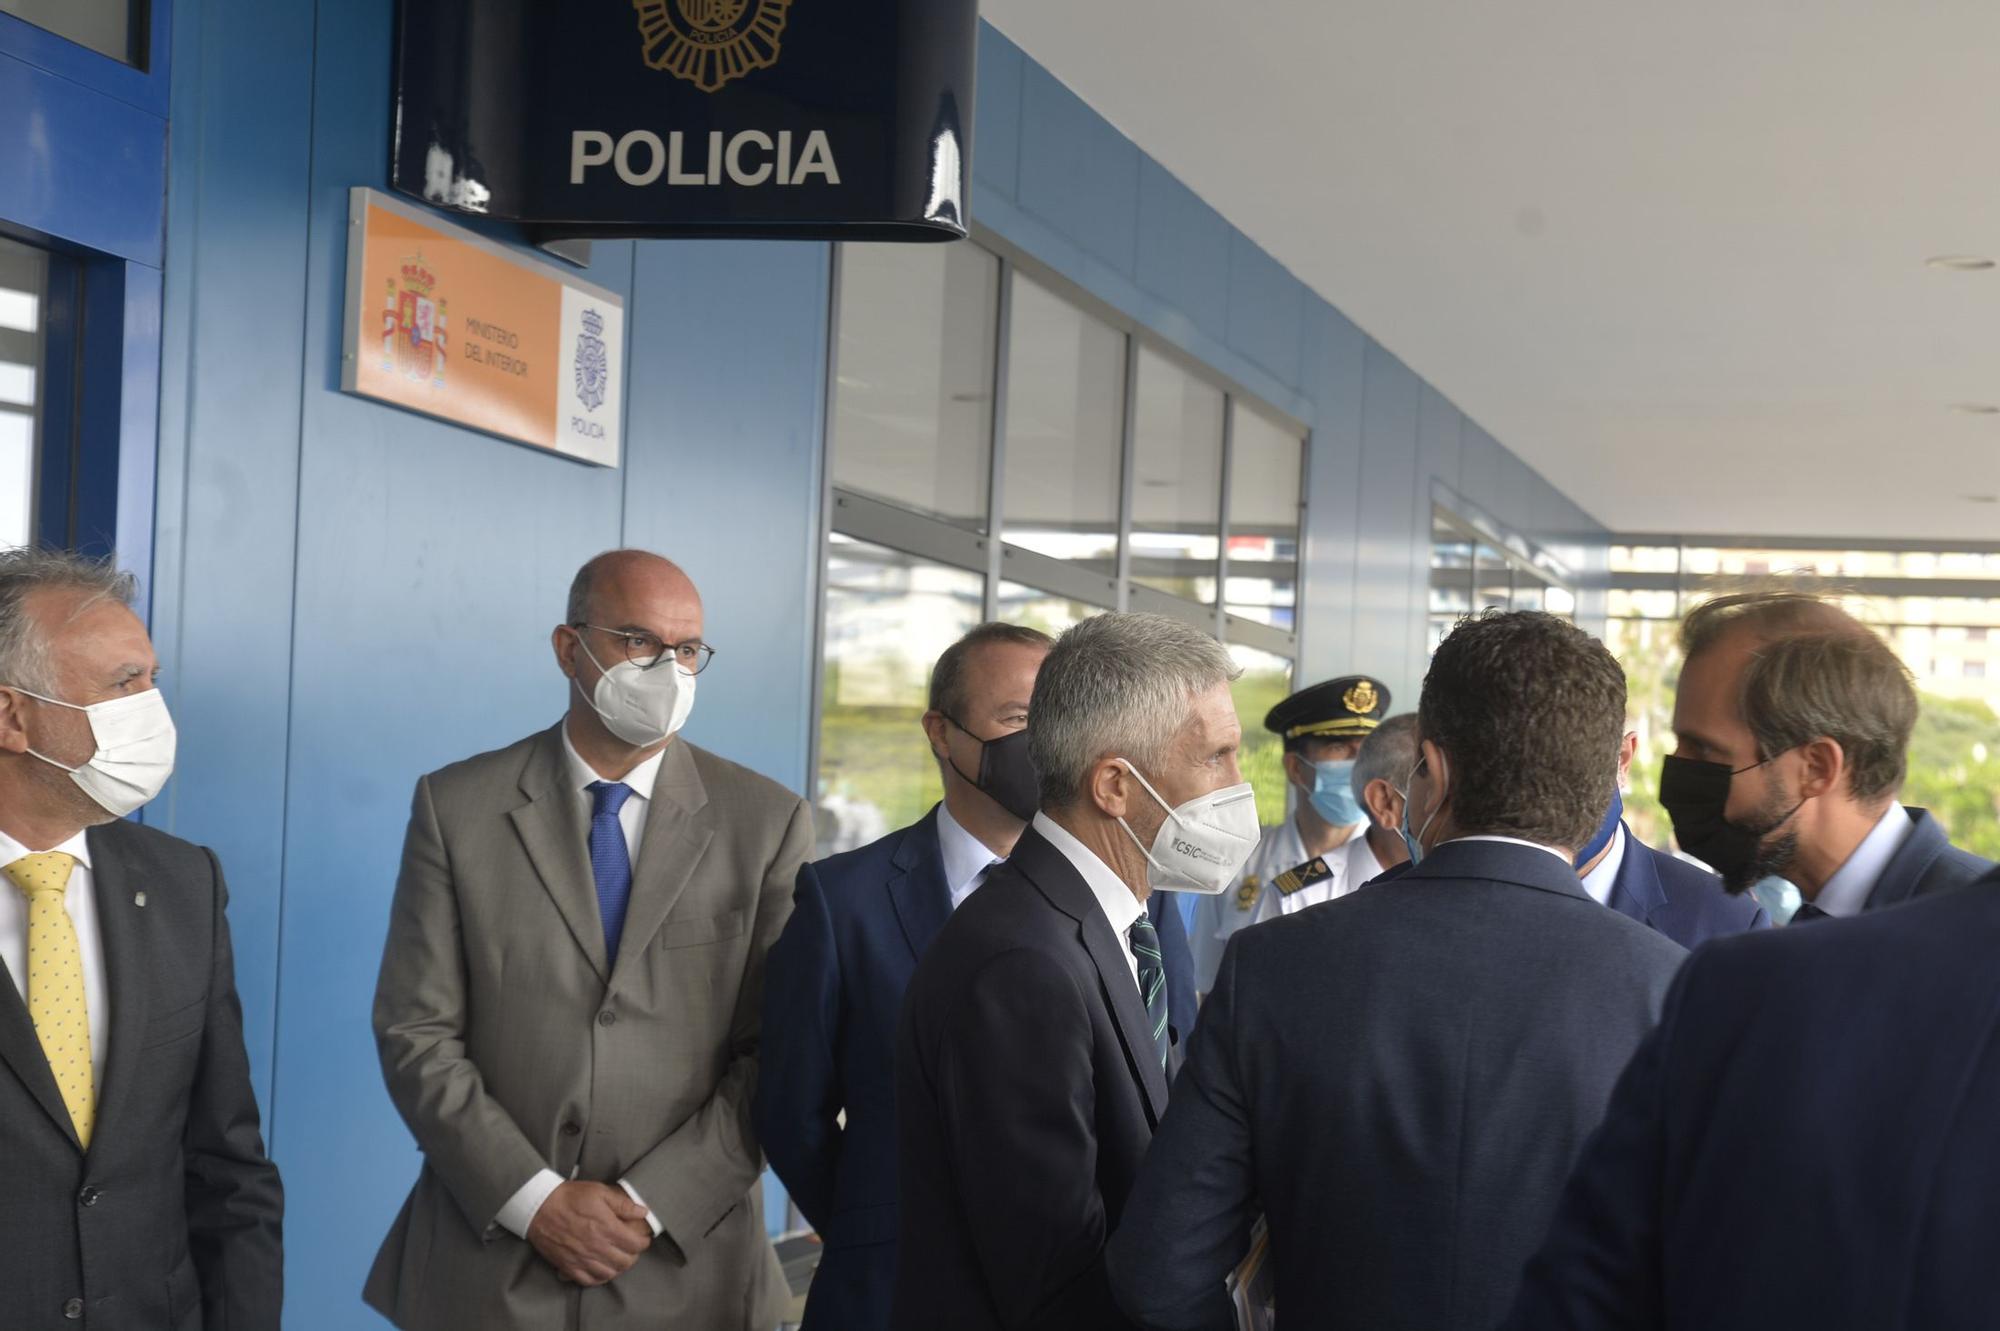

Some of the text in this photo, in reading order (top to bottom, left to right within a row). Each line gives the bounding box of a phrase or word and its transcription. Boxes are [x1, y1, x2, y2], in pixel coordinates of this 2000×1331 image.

[570, 129, 841, 186] POLICIA
[466, 317, 518, 349] MINISTERIO
[465, 342, 528, 377] DEL INTERIOR
